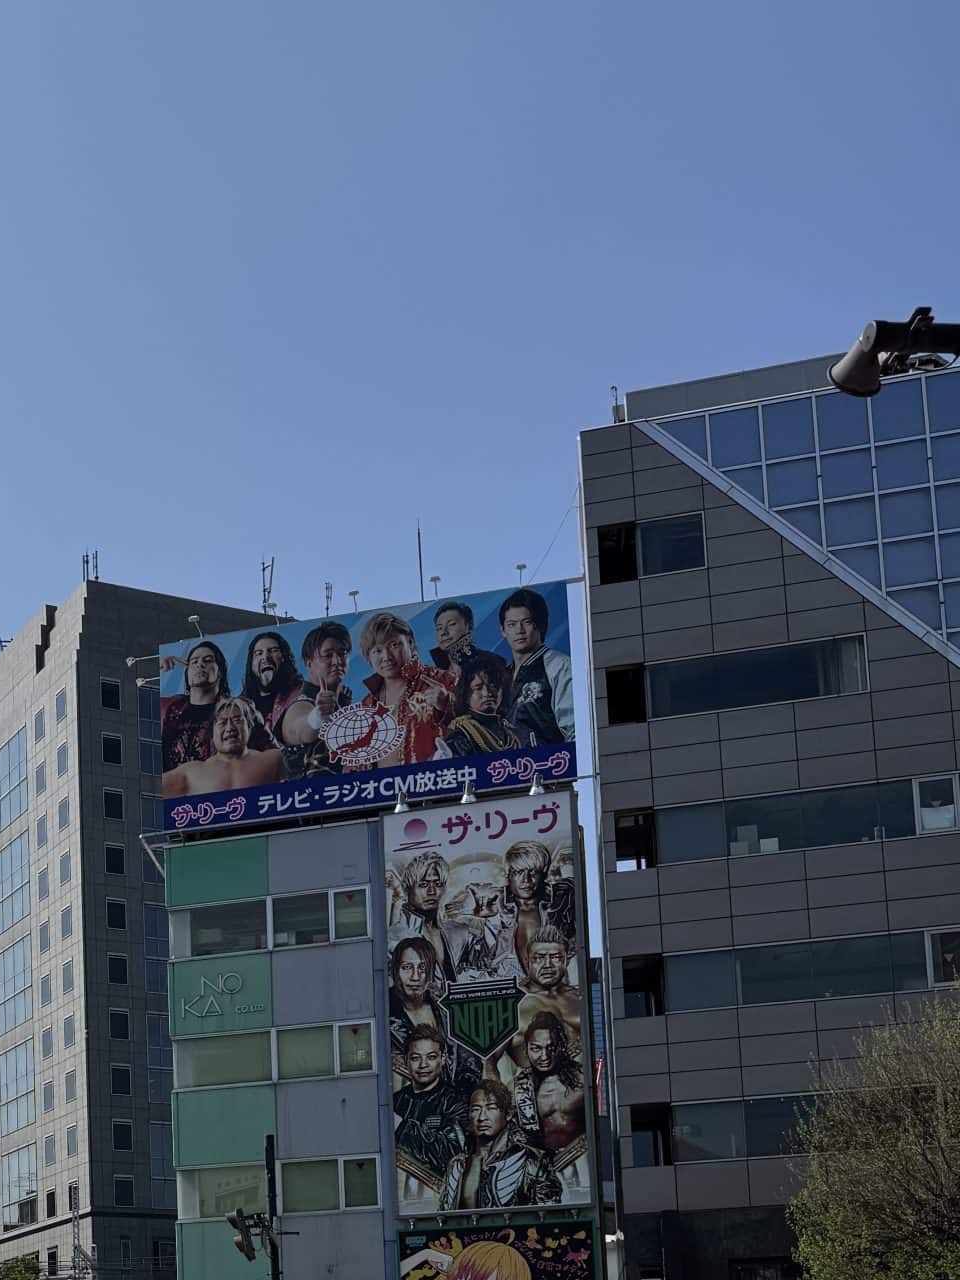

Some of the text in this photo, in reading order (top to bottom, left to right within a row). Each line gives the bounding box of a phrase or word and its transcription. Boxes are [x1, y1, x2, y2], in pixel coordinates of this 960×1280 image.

[487, 751, 571, 783] ザ・リーヴ
[257, 766, 477, 814] テレビ・ラジオCM放送中
[171, 797, 246, 827] ザ・リーヴ
[441, 802, 560, 845] ザ・リーヴ
[448, 998, 517, 1050] NOAH
